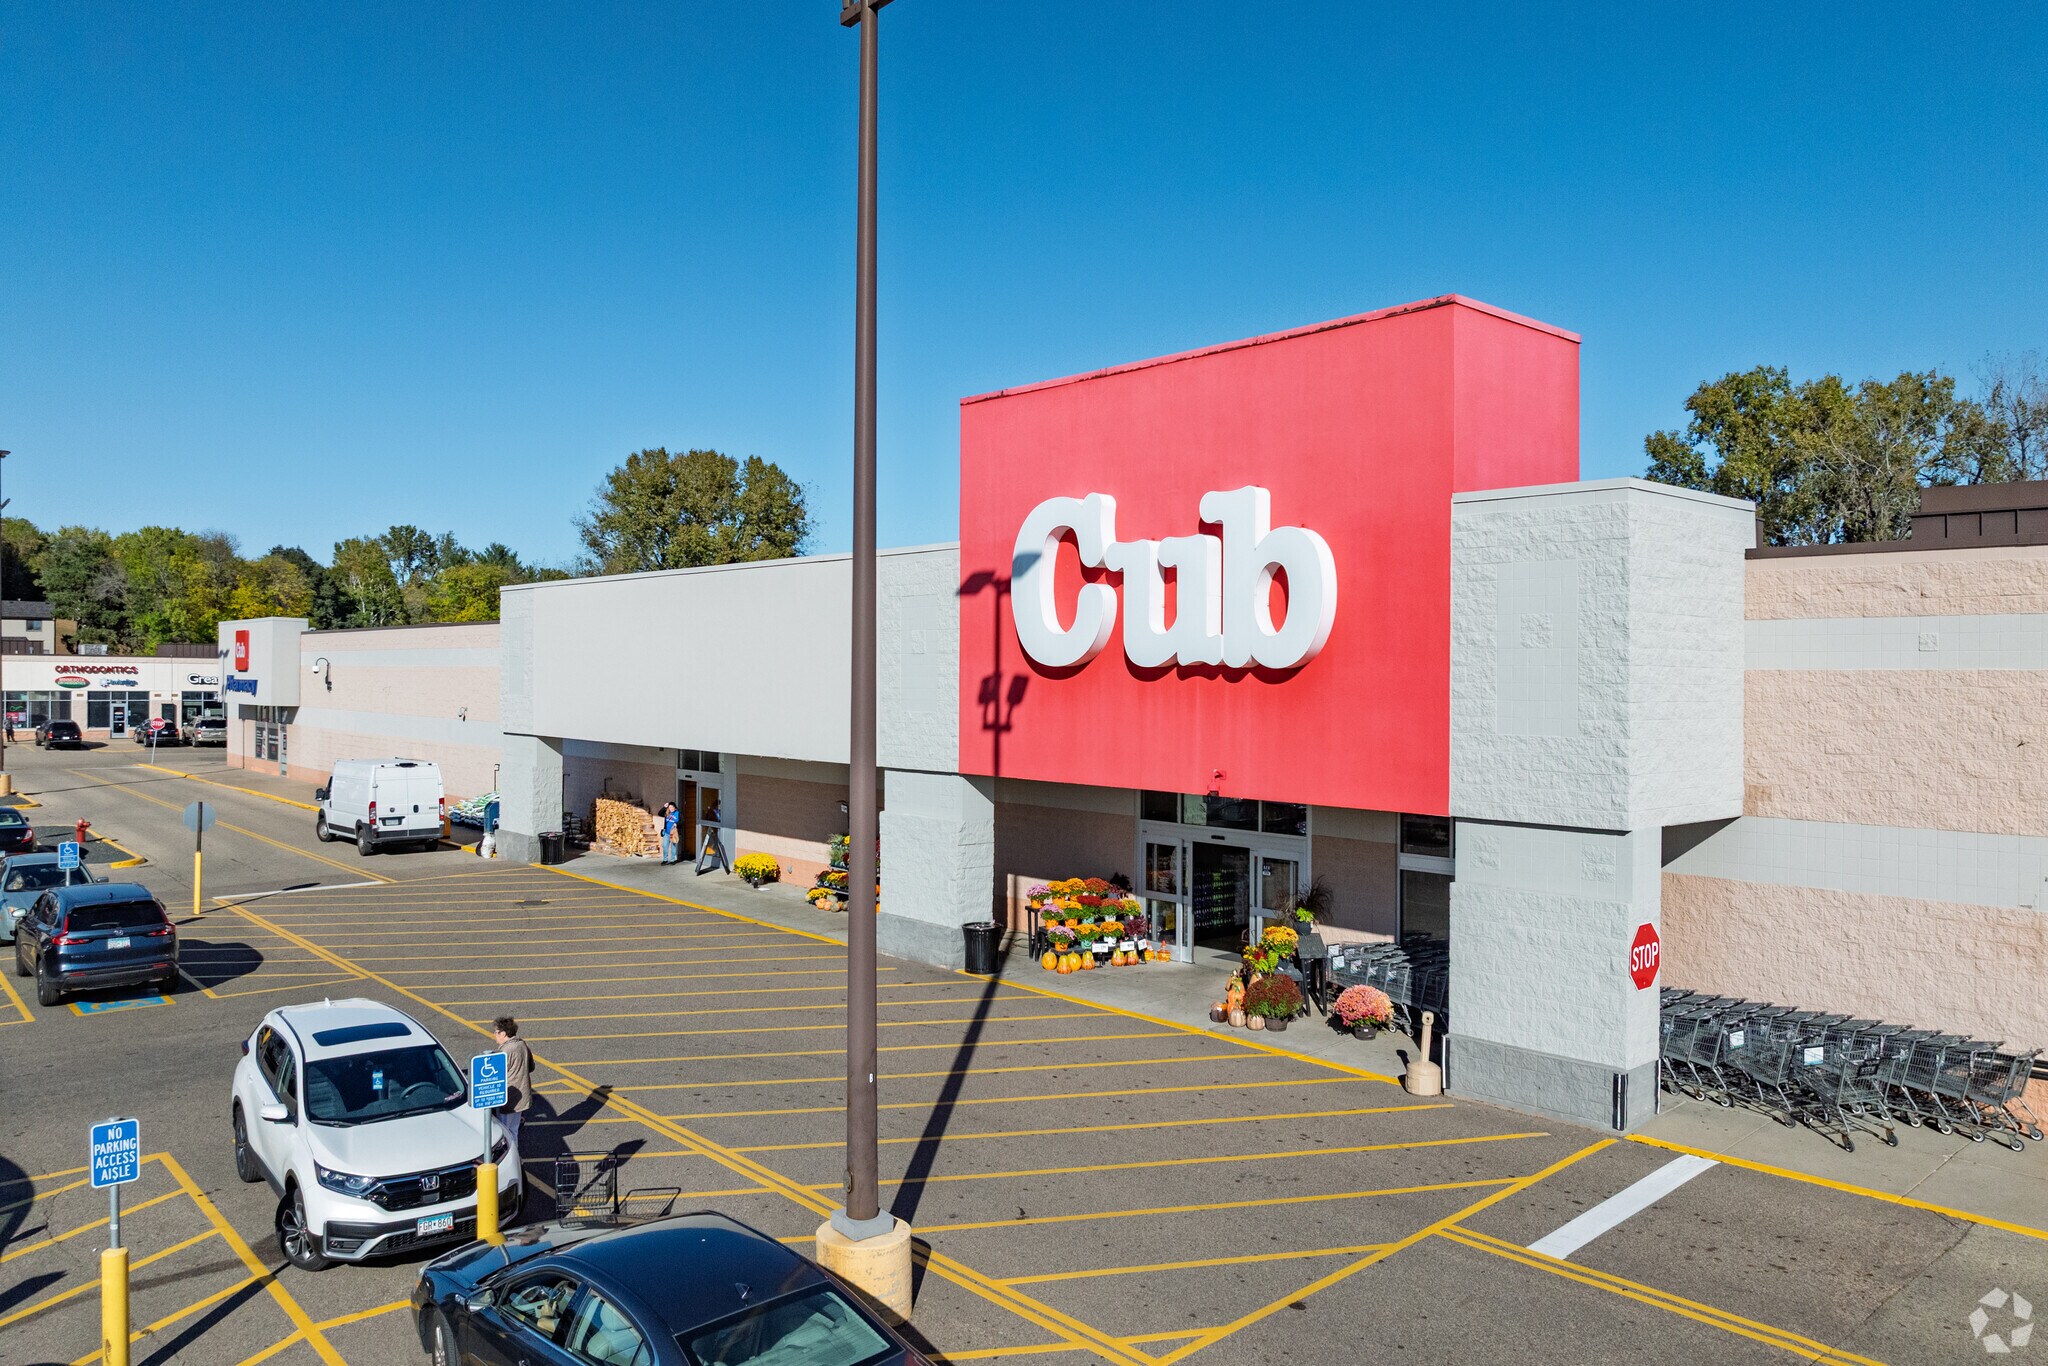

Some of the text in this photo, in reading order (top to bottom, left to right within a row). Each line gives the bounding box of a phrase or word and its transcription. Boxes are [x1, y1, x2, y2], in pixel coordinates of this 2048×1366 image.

[1011, 485, 1337, 669] Cub
[236, 642, 245, 658] Cub
[55, 665, 139, 674] ORTHODONTICS
[1632, 941, 1659, 972] STOP
[108, 1127, 122, 1140] NO
[94, 1138, 136, 1156] PARKING
[96, 1151, 136, 1169] ACCESS
[101, 1165, 131, 1181] AISLE
